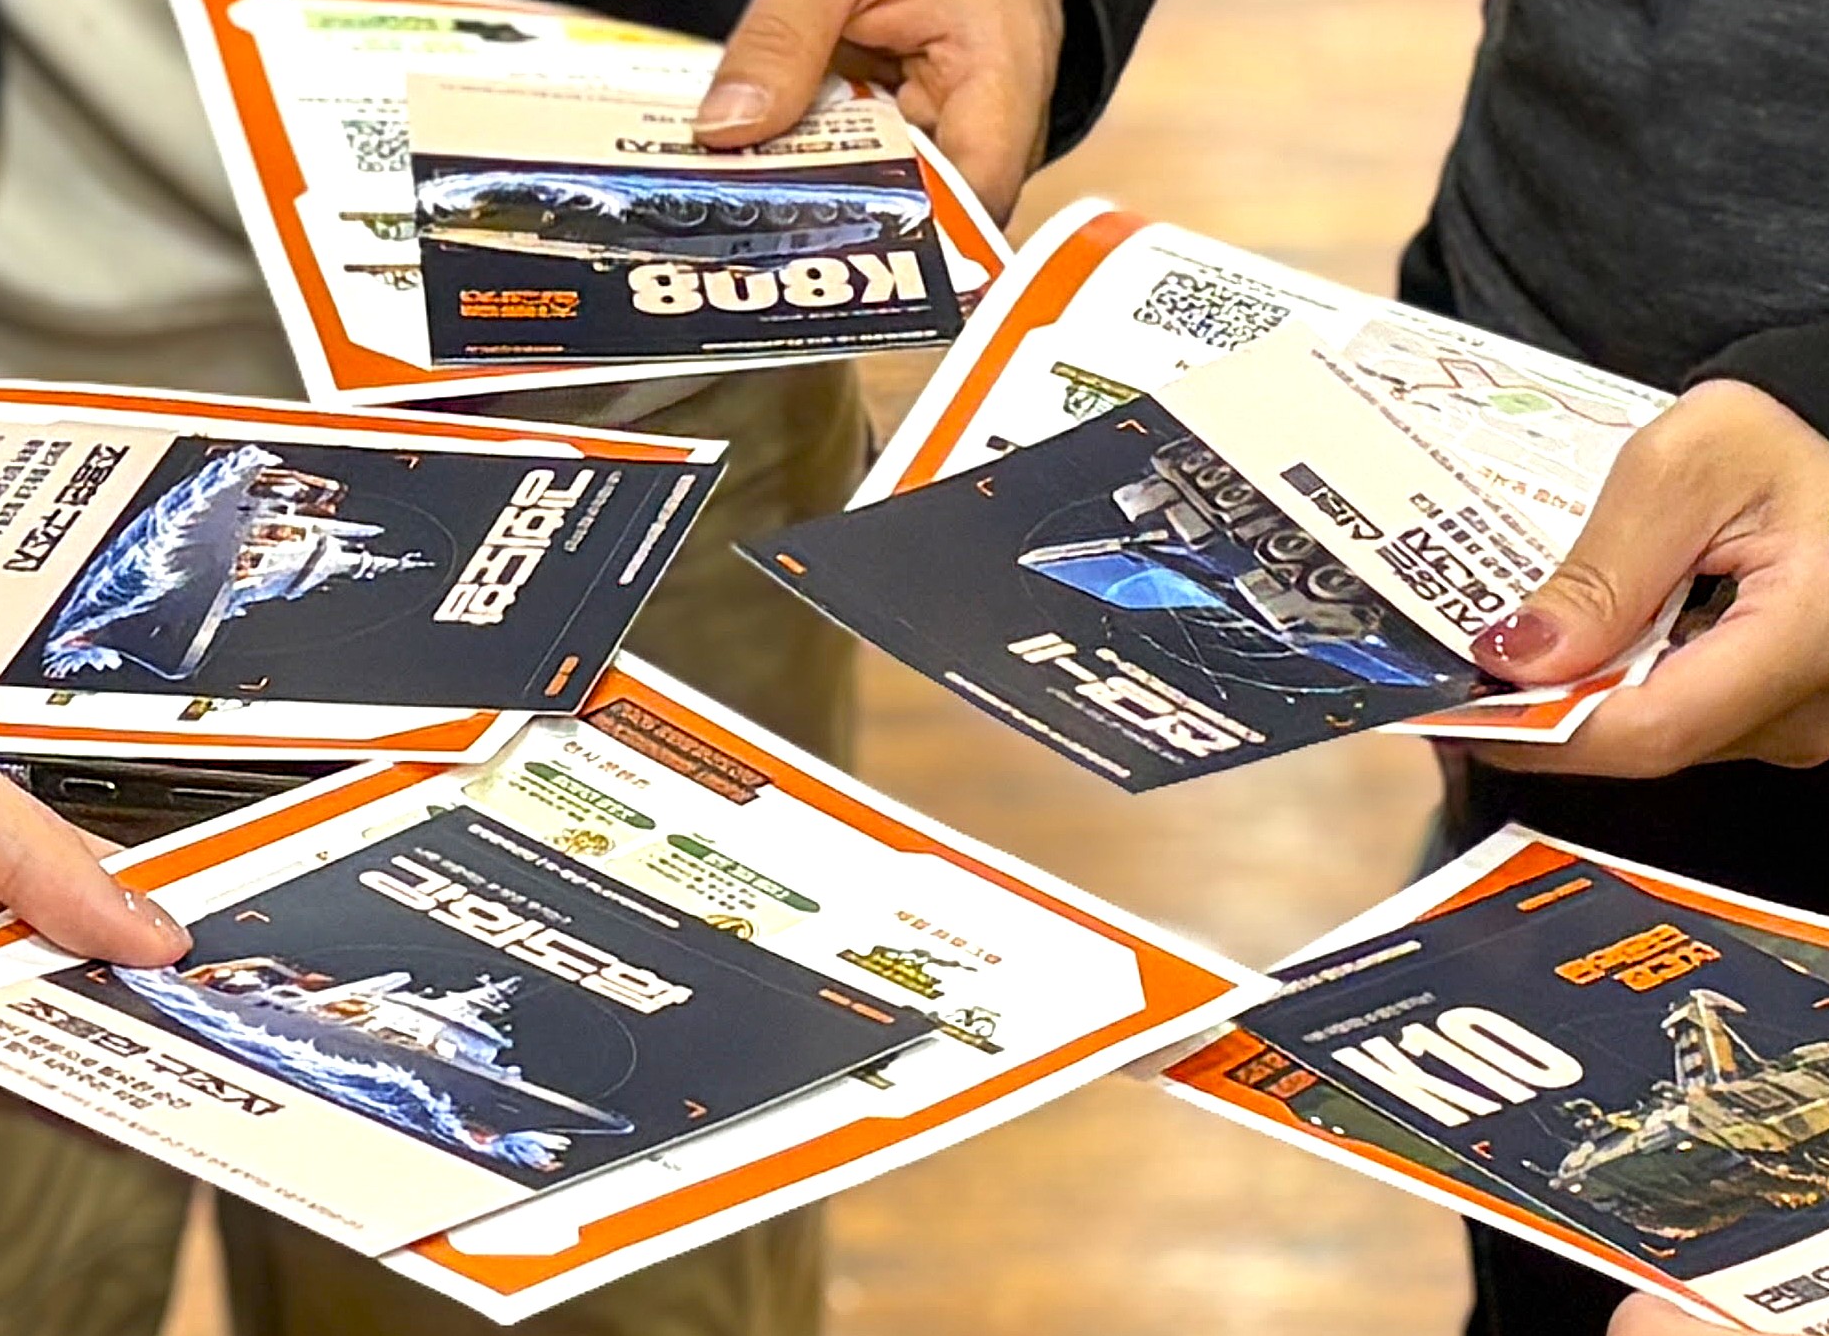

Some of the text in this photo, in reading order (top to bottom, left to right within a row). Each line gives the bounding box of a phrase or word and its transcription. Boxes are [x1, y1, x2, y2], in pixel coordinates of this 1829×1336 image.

[628, 250, 928, 316] K808
[2, 507, 82, 573] 구조자
[361, 853, 696, 1018] 강화도함
[146, 1054, 286, 1117] 구조자
[1329, 1004, 1584, 1128] K10
